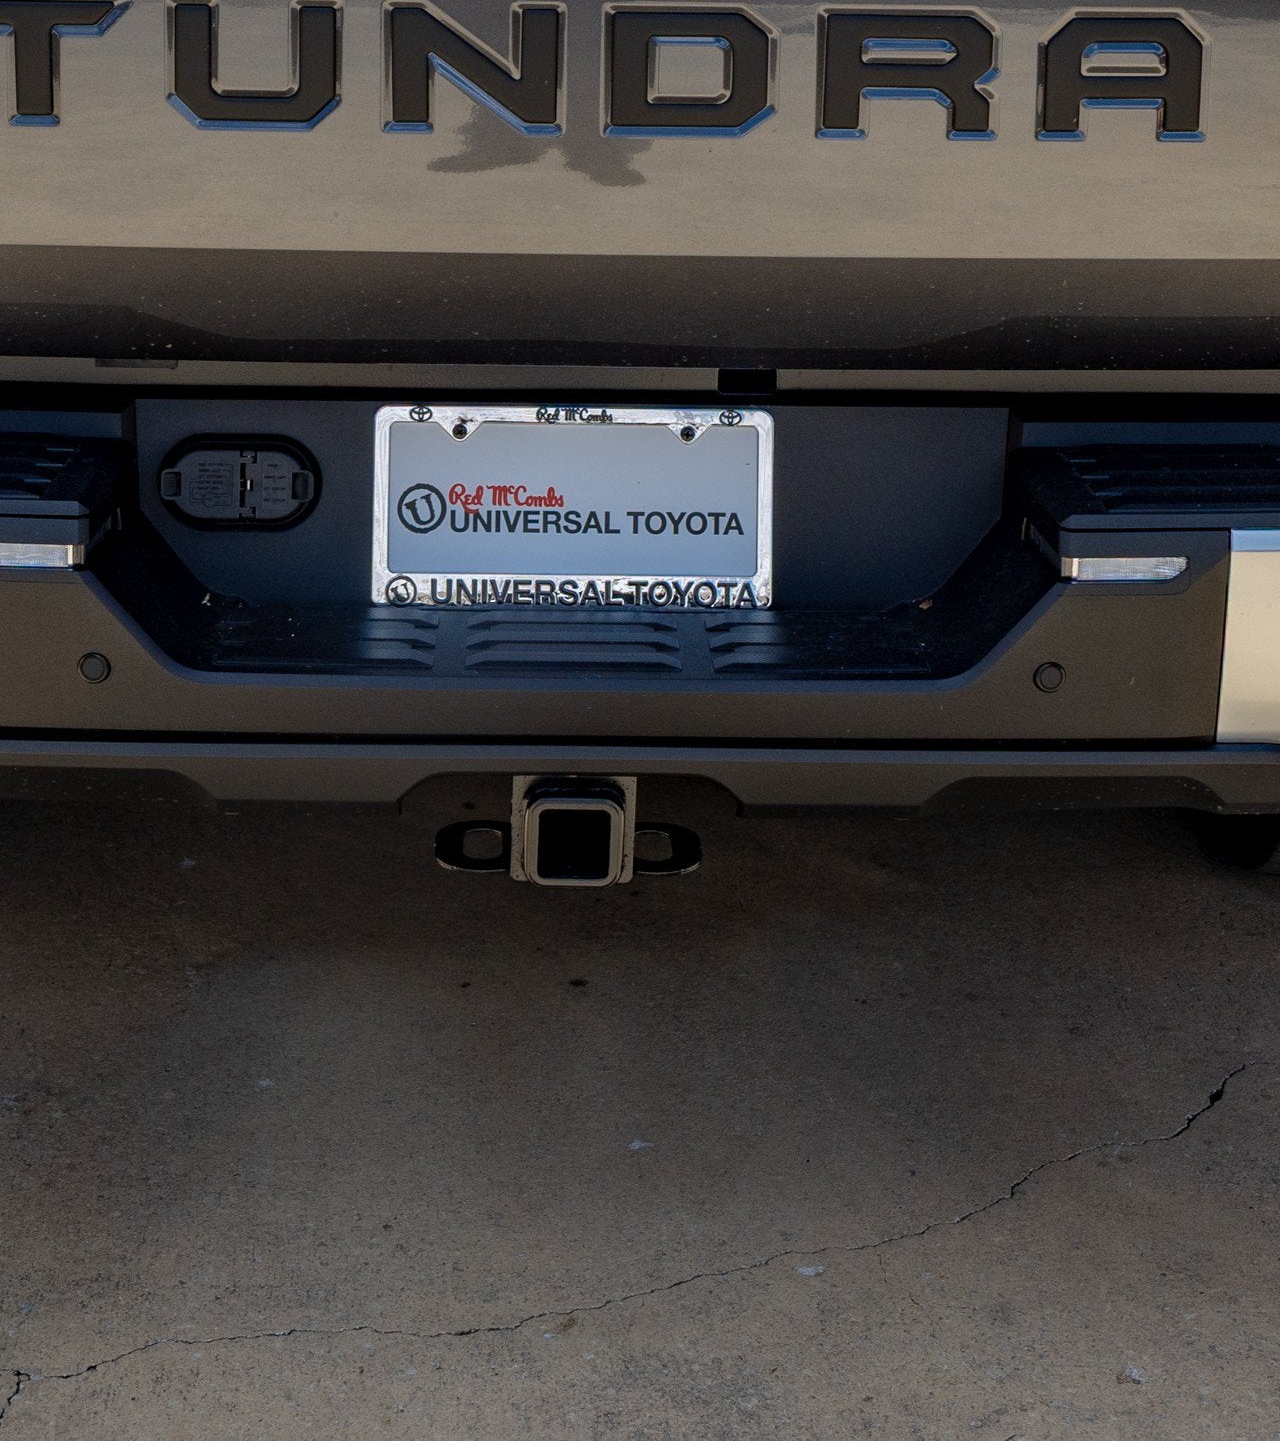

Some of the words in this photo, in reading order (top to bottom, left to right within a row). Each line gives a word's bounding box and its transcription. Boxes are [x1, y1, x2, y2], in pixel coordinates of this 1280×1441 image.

[536, 407, 560, 424] Red
[561, 407, 613, 422] McCombs
[449, 483, 484, 514] Red
[486, 485, 565, 508] McCombs
[450, 509, 621, 535] UNIVERSAL
[626, 511, 745, 536] TOYOTA
[430, 577, 625, 607] UNIVERSAL
[627, 580, 758, 609] TOYOTA
